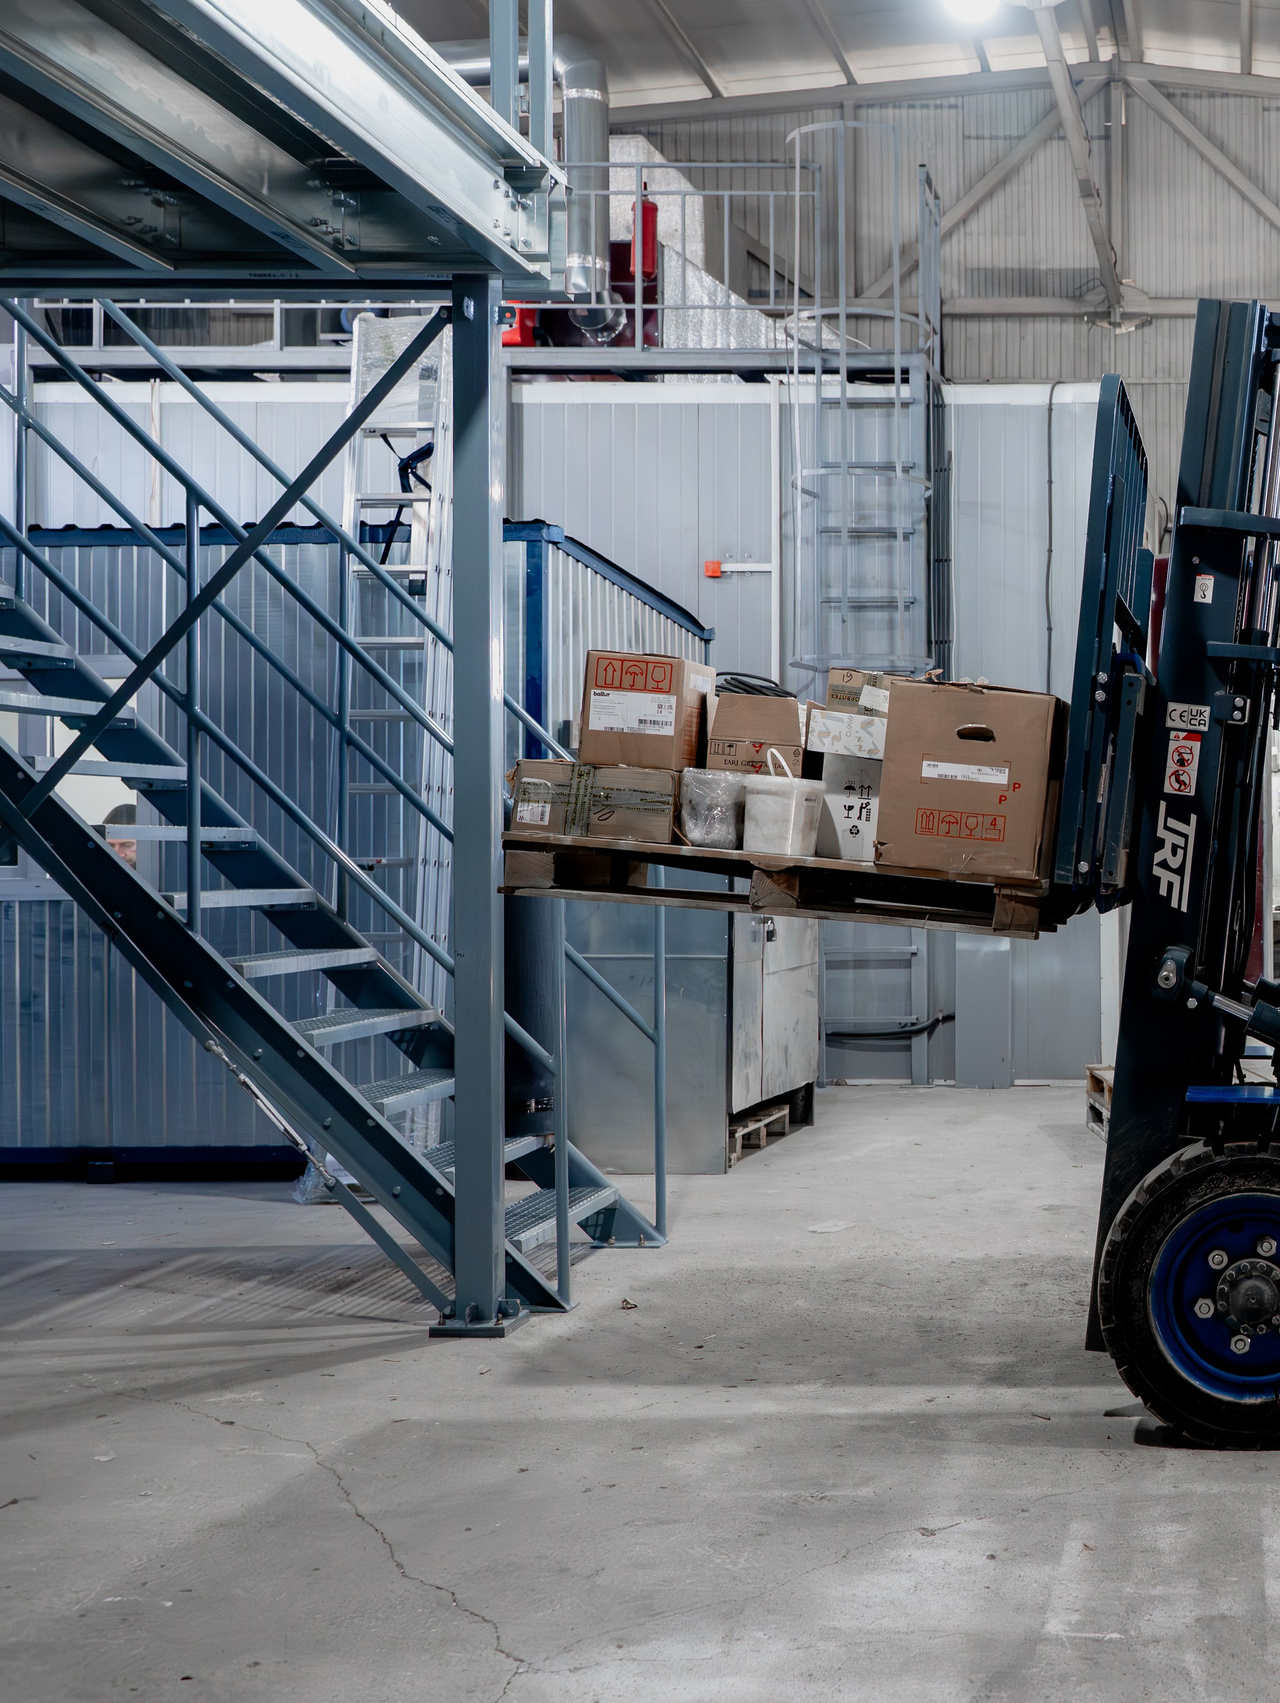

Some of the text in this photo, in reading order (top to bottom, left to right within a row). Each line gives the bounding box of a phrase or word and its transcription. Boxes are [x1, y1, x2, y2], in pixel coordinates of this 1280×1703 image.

[1168, 708, 1188, 724] CE
[1190, 708, 1208, 719] UK
[1189, 717, 1207, 728] CA
[1012, 782, 1022, 792] P
[998, 794, 1008, 805] P
[1152, 800, 1198, 914] TRF
